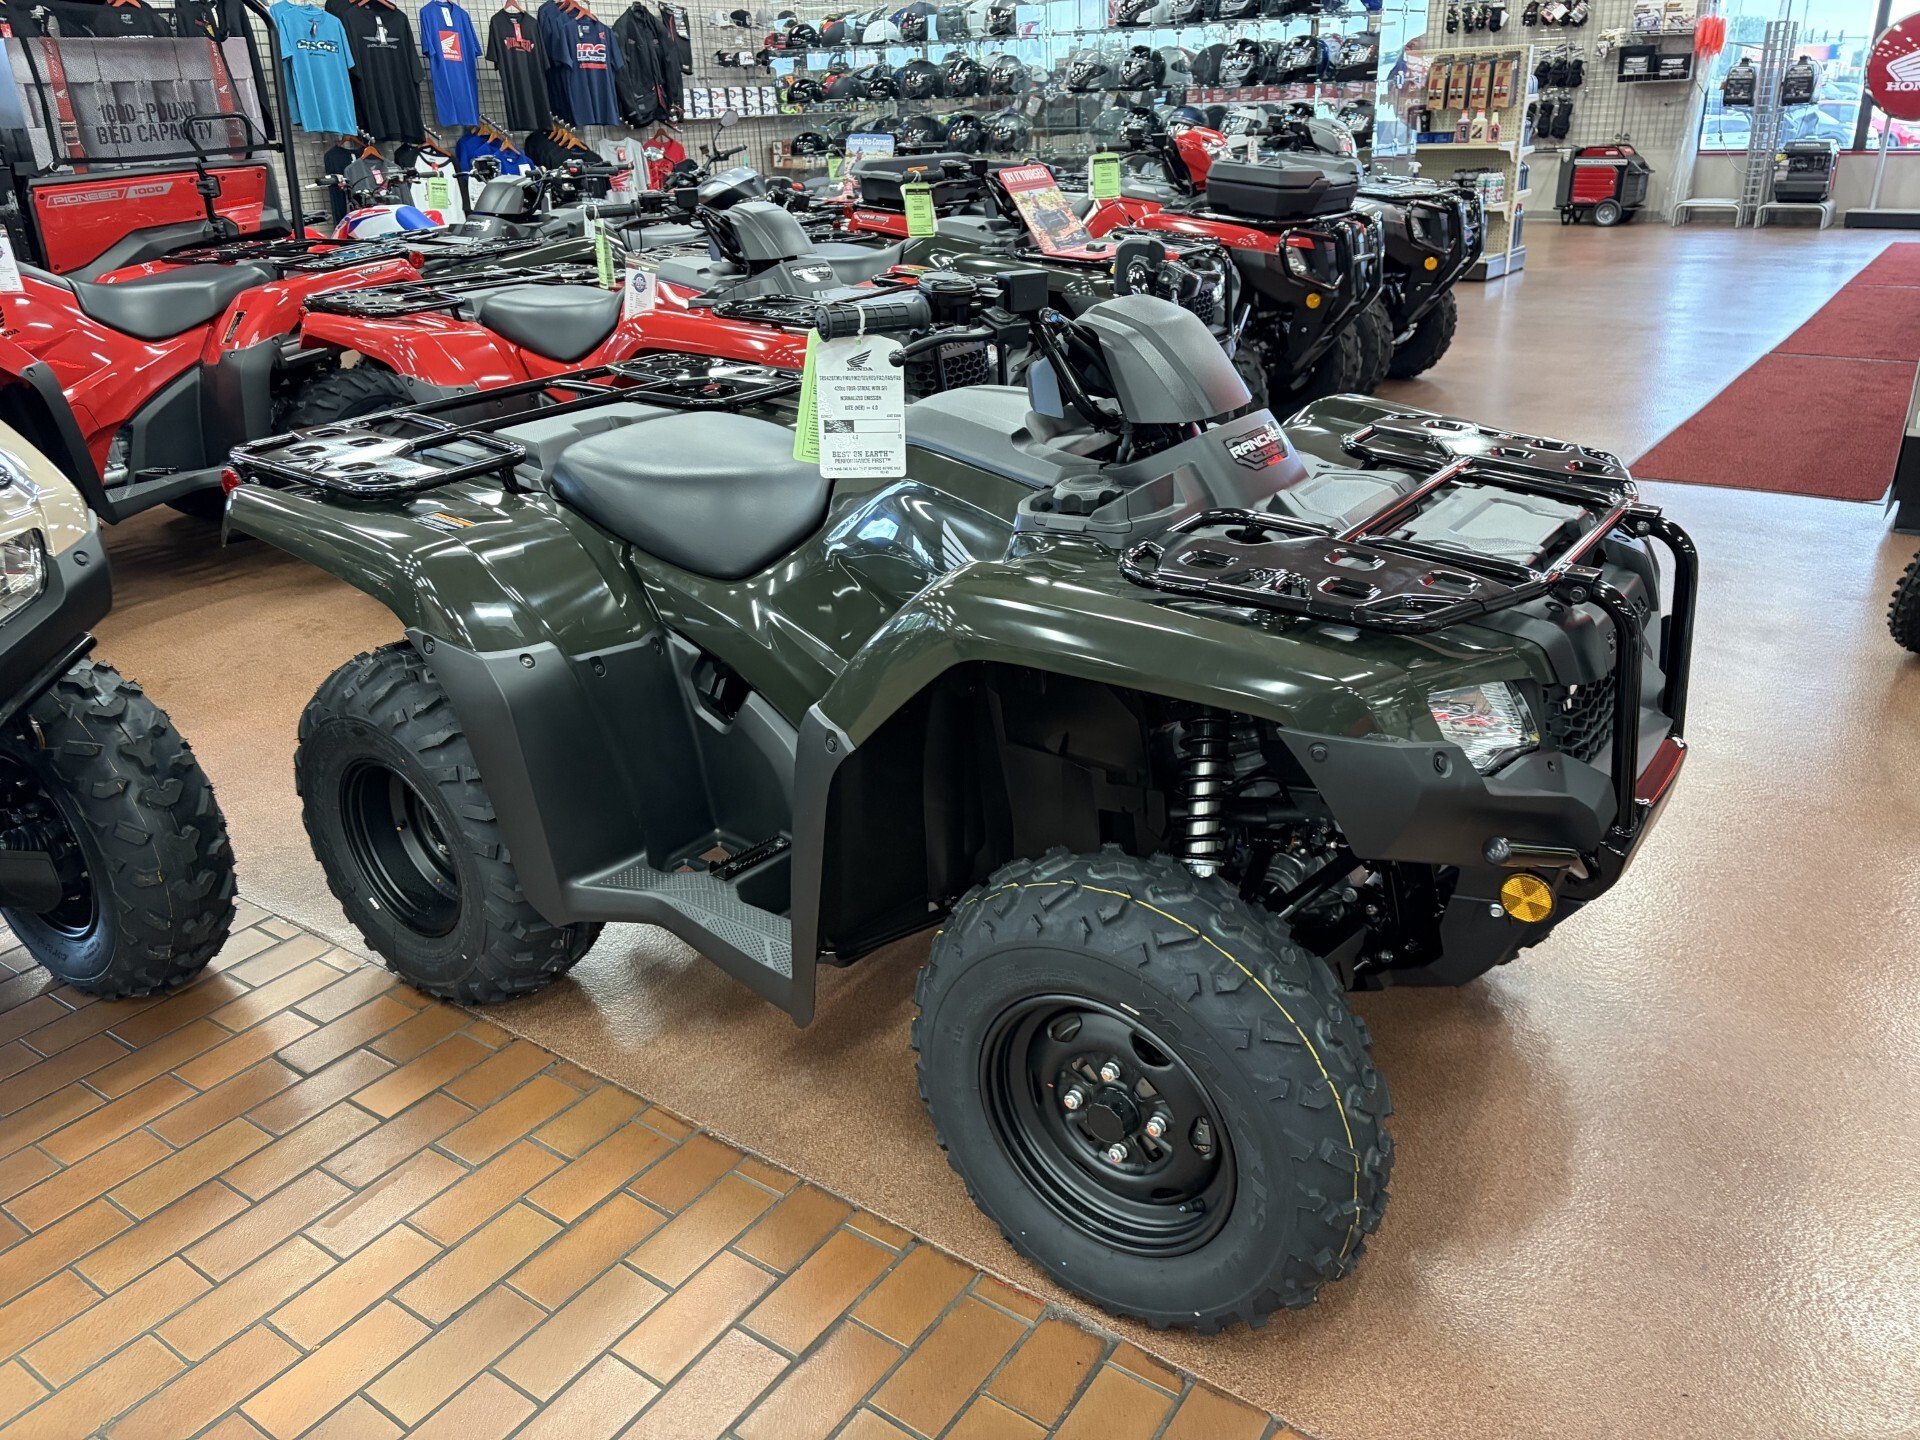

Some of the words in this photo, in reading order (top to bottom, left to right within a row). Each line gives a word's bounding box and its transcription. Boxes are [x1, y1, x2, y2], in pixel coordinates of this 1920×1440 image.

[577, 44, 606, 58] HRC
[96, 124, 133, 144] BED
[136, 121, 213, 143] CAPACITY
[1002, 171, 1016, 183] TRY
[1013, 170, 1022, 182] IT
[1021, 167, 1047, 181] YOURSELF
[53, 190, 119, 205] PIONEER
[133, 186, 164, 195] 1000
